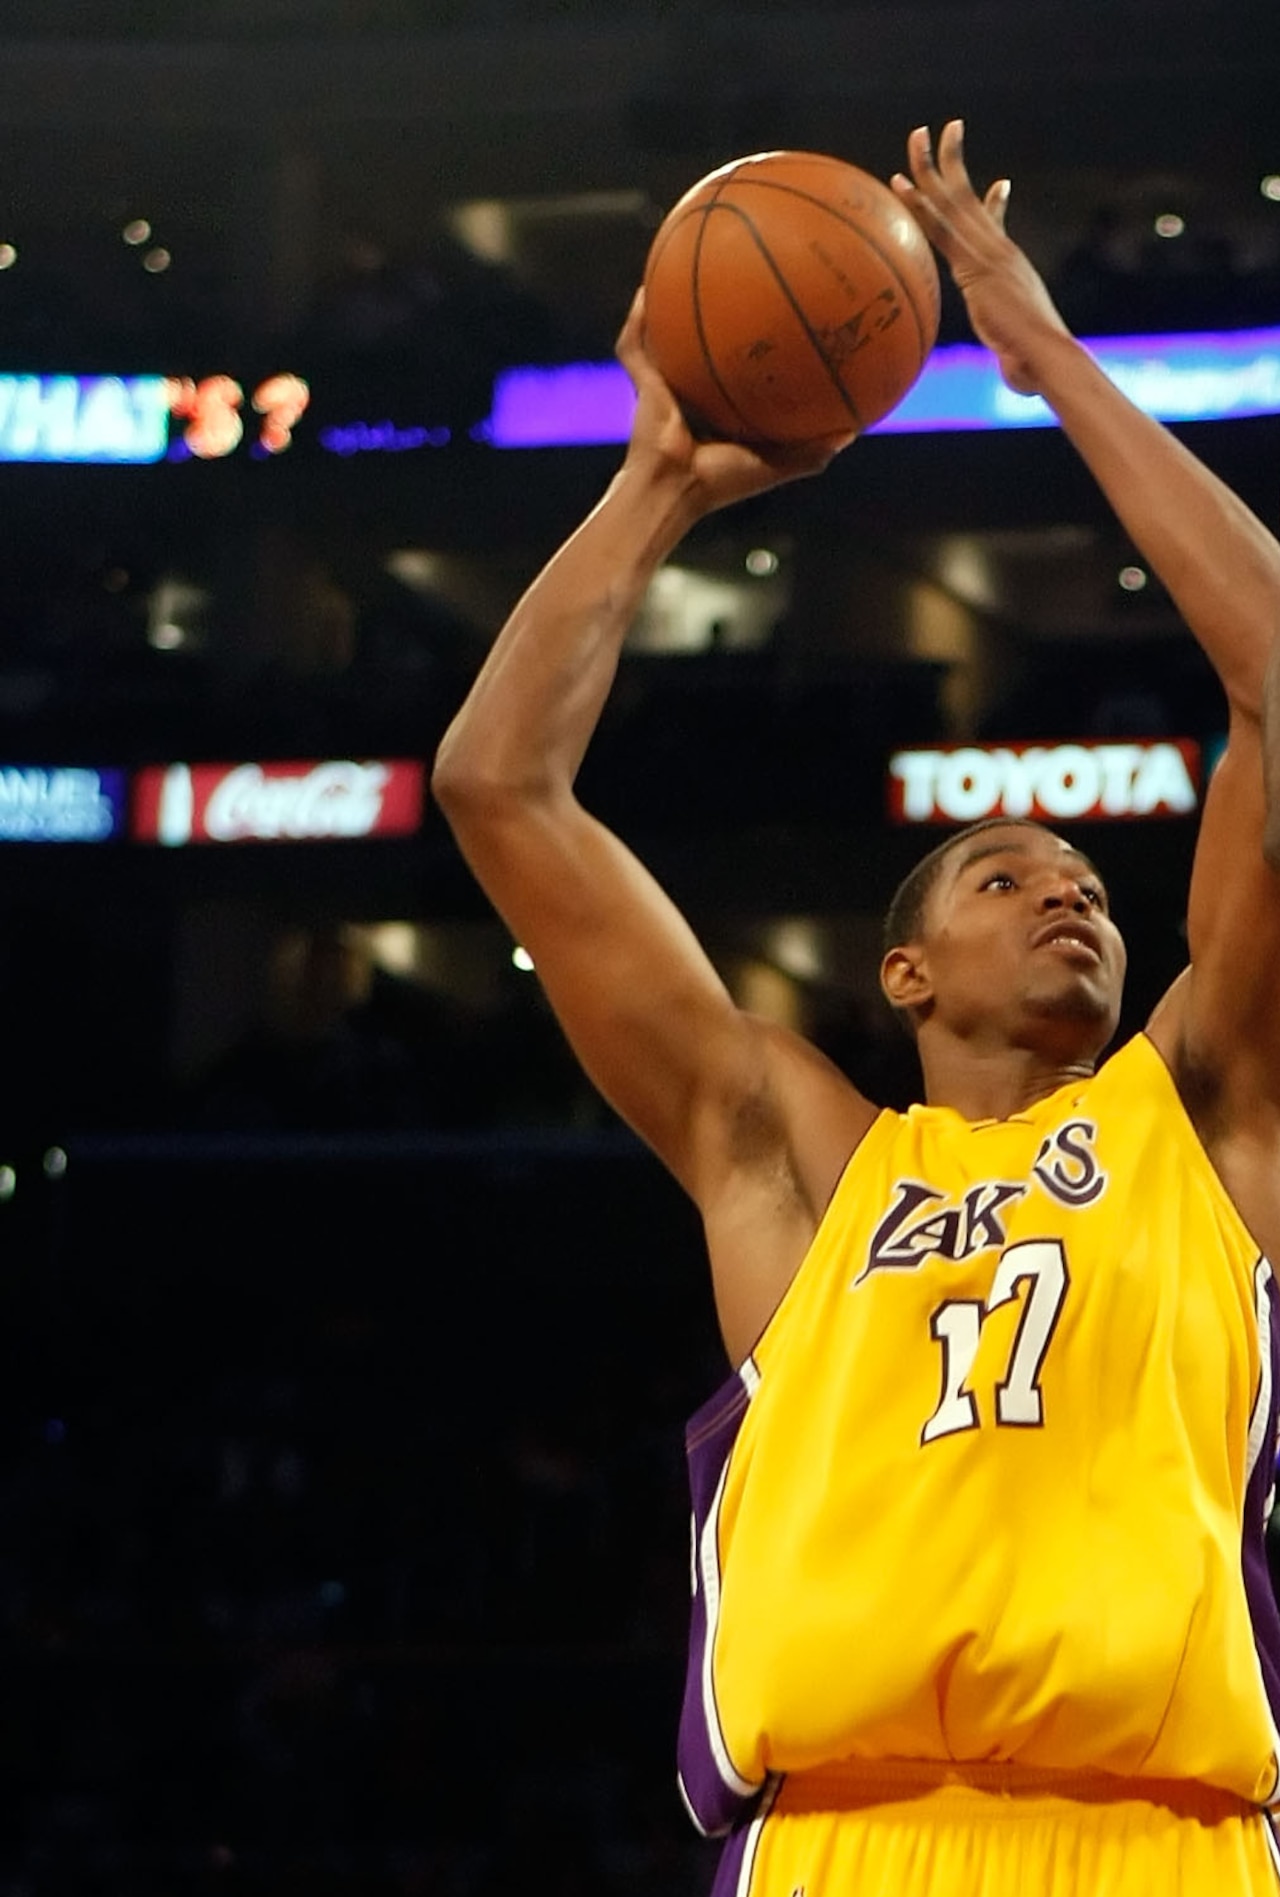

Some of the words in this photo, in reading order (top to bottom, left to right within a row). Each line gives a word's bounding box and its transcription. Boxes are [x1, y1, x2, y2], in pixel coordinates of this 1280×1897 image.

[889, 743, 1196, 822] TOYOTA
[851, 1119, 1107, 1290] LAKS
[919, 1238, 1071, 1448] 17
